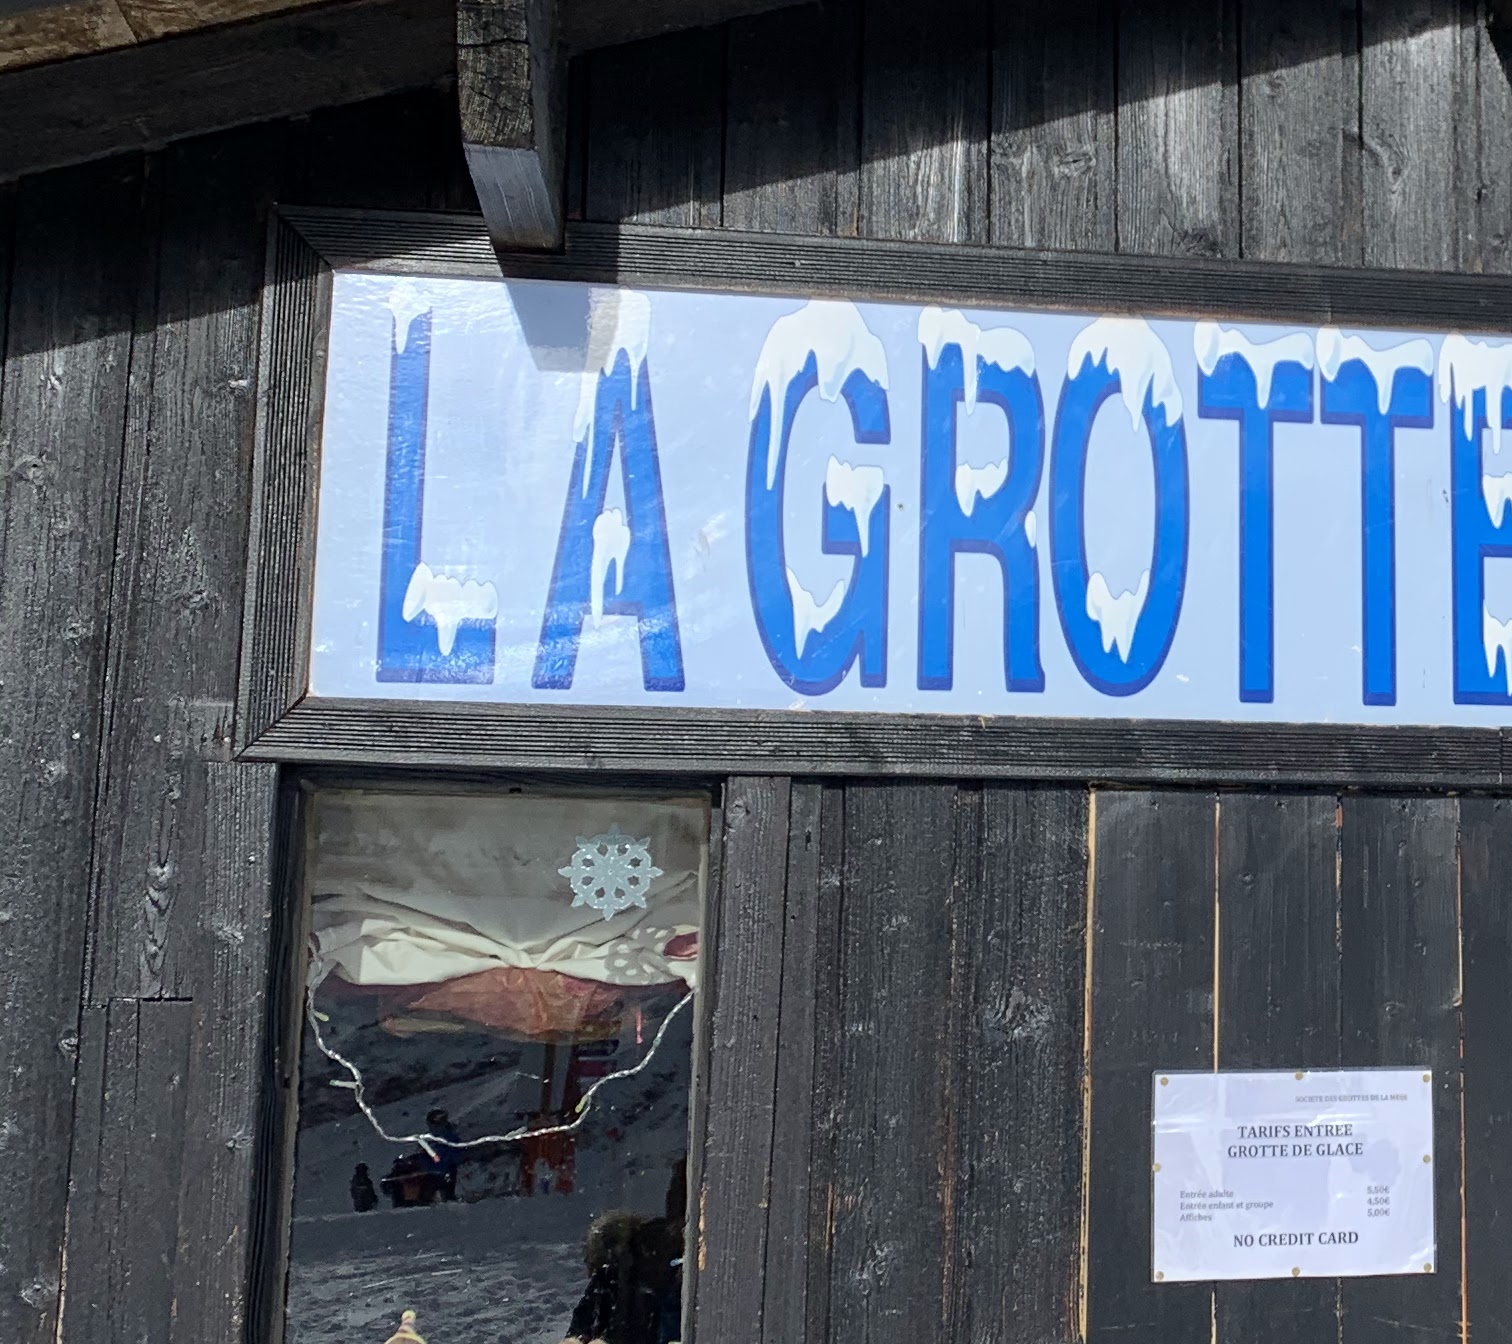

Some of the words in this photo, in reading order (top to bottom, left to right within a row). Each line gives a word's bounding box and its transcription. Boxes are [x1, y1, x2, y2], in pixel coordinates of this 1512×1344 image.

[376, 282, 685, 692] LA
[1237, 1124, 1291, 1139] TARIFS
[1294, 1123, 1353, 1137] ENTREE
[1228, 1144, 1288, 1158] GROTTE
[1292, 1143, 1312, 1157] DE
[1316, 1142, 1363, 1156] GLACE
[1180, 1189, 1206, 1198] Entrée
[1208, 1189, 1234, 1198] adulte
[1180, 1201, 1206, 1210] Entrée
[1208, 1200, 1234, 1210] enfant
[1236, 1201, 1243, 1209] et
[1245, 1201, 1274, 1211] groupe
[1367, 1197, 1390, 1206] 4,50€
[1180, 1212, 1212, 1222] Affiches
[1233, 1234, 1254, 1247] NO
[1258, 1233, 1315, 1246] CREDIT
[1318, 1231, 1359, 1245] CARD
